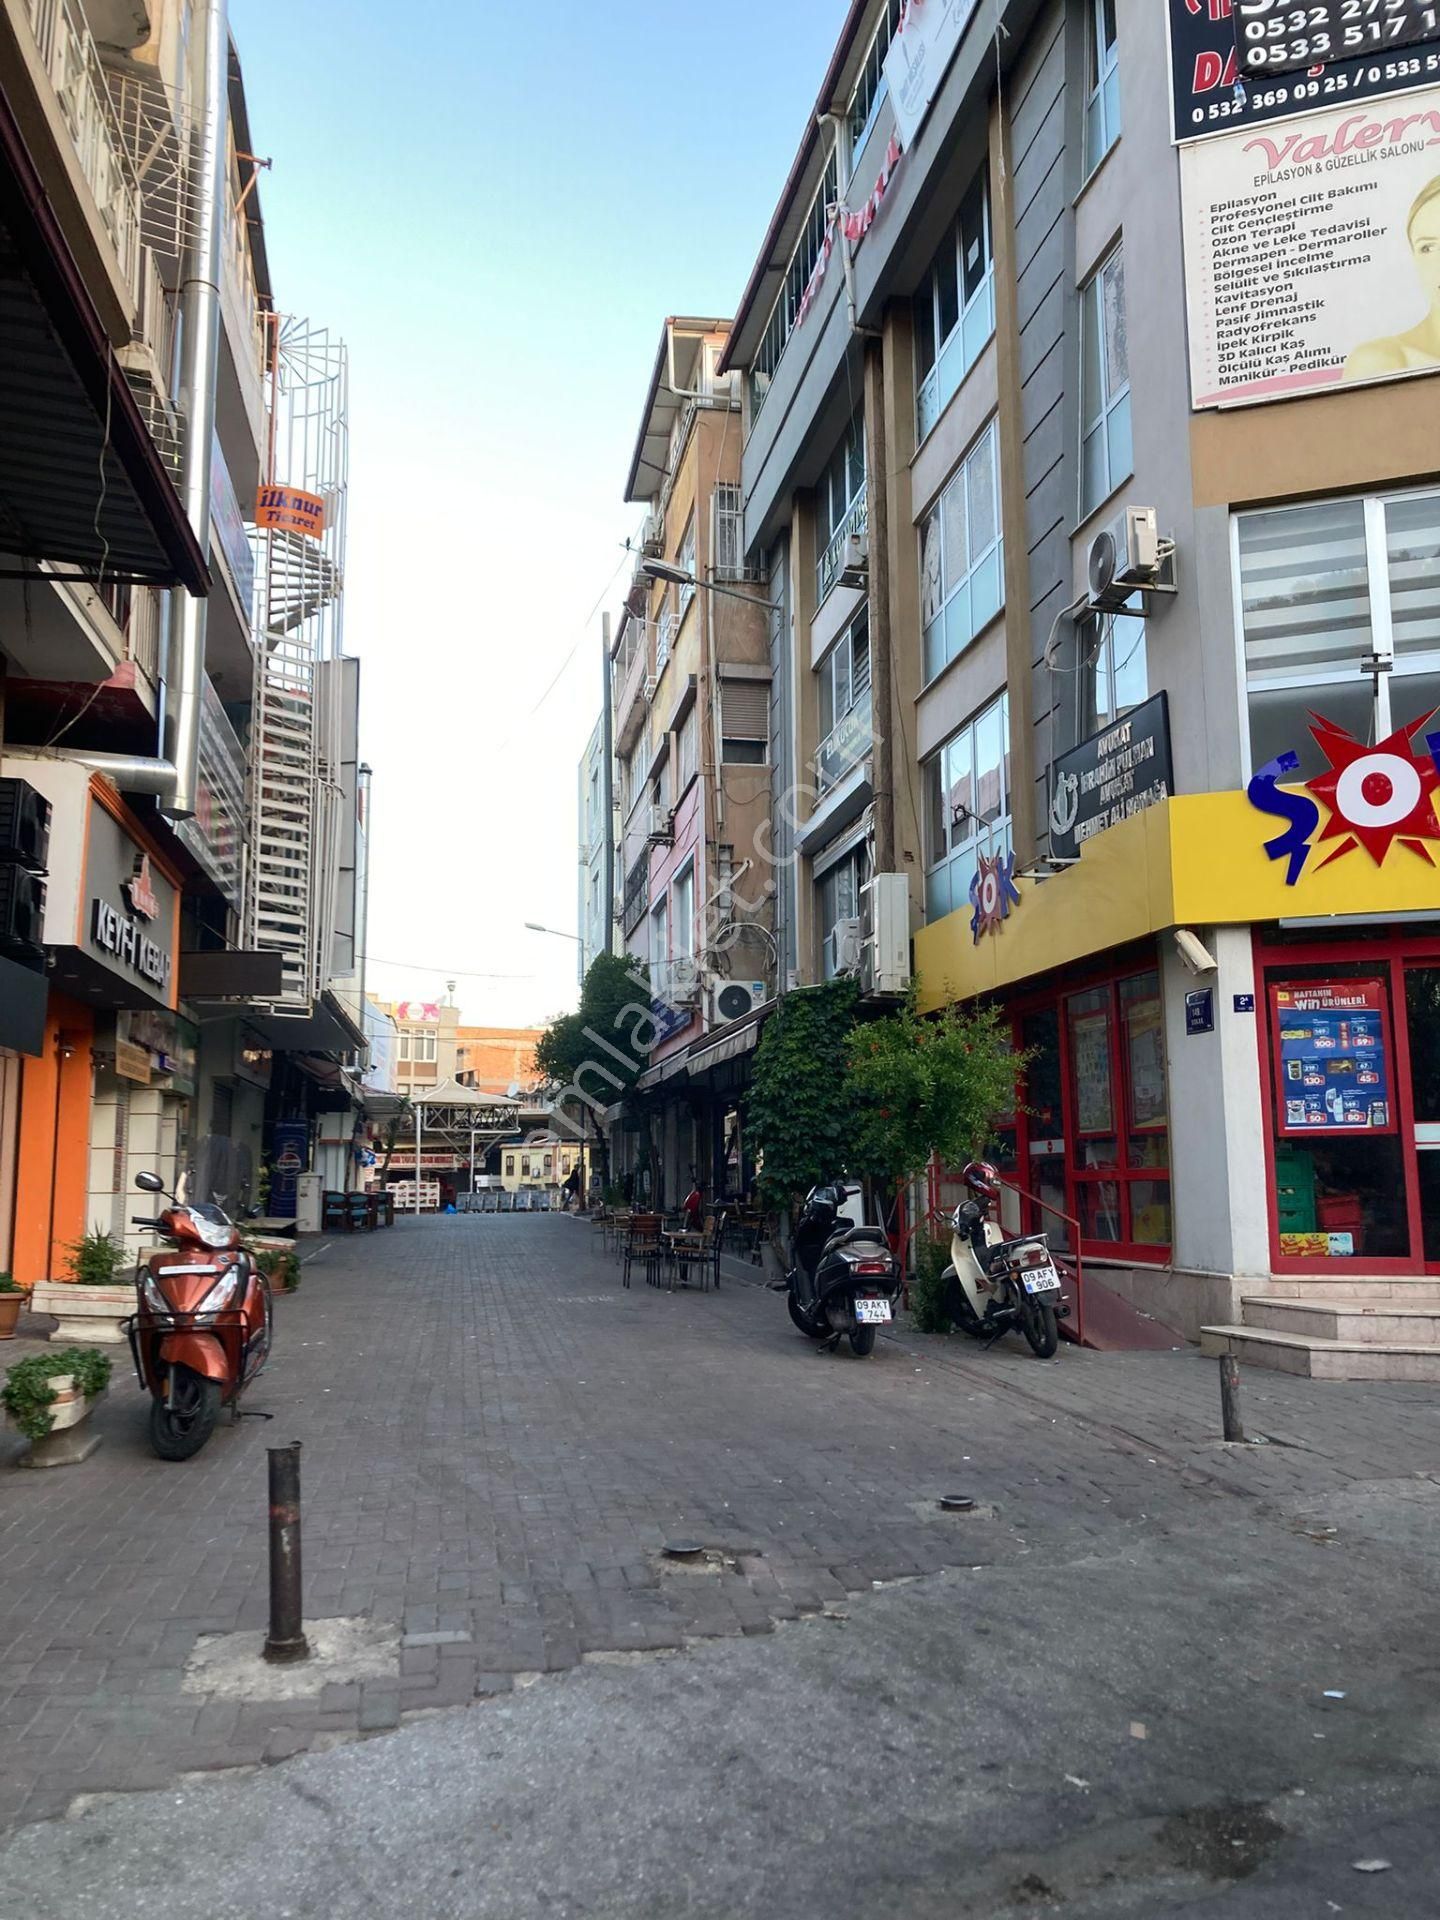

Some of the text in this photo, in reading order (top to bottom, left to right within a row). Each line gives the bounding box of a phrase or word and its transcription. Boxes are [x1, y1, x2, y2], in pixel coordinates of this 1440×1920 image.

[1245, 7, 1329, 39] 0532
[1247, 32, 1331, 65] 0533
[1343, 15, 1407, 45] 517
[1192, 54, 1440, 123] 0 532 369 09 25 / 0 533 5
[1254, 140, 1425, 187] EPİLASYON & GÜZELLİK SALONU
[1210, 192, 1277, 212] Epilasyon
[1211, 182, 1377, 224] Profesyonel Cilt Bakımı
[1211, 203, 1333, 236] Cilt Gençleştirme
[1212, 221, 1296, 247] Ozon Terapi
[1213, 217, 1370, 259] Akne ve Leke Tedavisi
[1213, 248, 1287, 270] Dermapen
[1299, 227, 1388, 252] Dermaroller
[1214, 262, 1272, 281] Bölgesel
[1214, 254, 1371, 293] Selülit ve Sıkılaştırma
[1215, 282, 1293, 305] Kavitasyon
[1215, 291, 1298, 316] Lenf Drenaj
[1216, 299, 1325, 328] Pasif Jimnastik
[1217, 313, 1317, 339] Radyofrekans
[1252, 329, 1294, 344] Kirpik
[1218, 339, 1305, 363] 3D Kalıcı Kaş
[1218, 347, 1331, 374] Ölçülü Kaş Alımı
[1219, 367, 1278, 386] Manikür
[1290, 354, 1348, 373] Pedikür
[1097, 721, 1132, 759] AVUKAT
[1100, 769, 1134, 806] AVUKAT
[1074, 809, 1110, 845] MEHMET
[1294, 989, 1332, 999] HAFTANIN
[1322, 993, 1366, 1007] ÜRÜNLERİ
[1023, 1268, 1054, 1283] 09 AFY
[1035, 1278, 1055, 1290] 906
[856, 1300, 888, 1310] 09 AKT
[867, 1309, 886, 1318] 744
